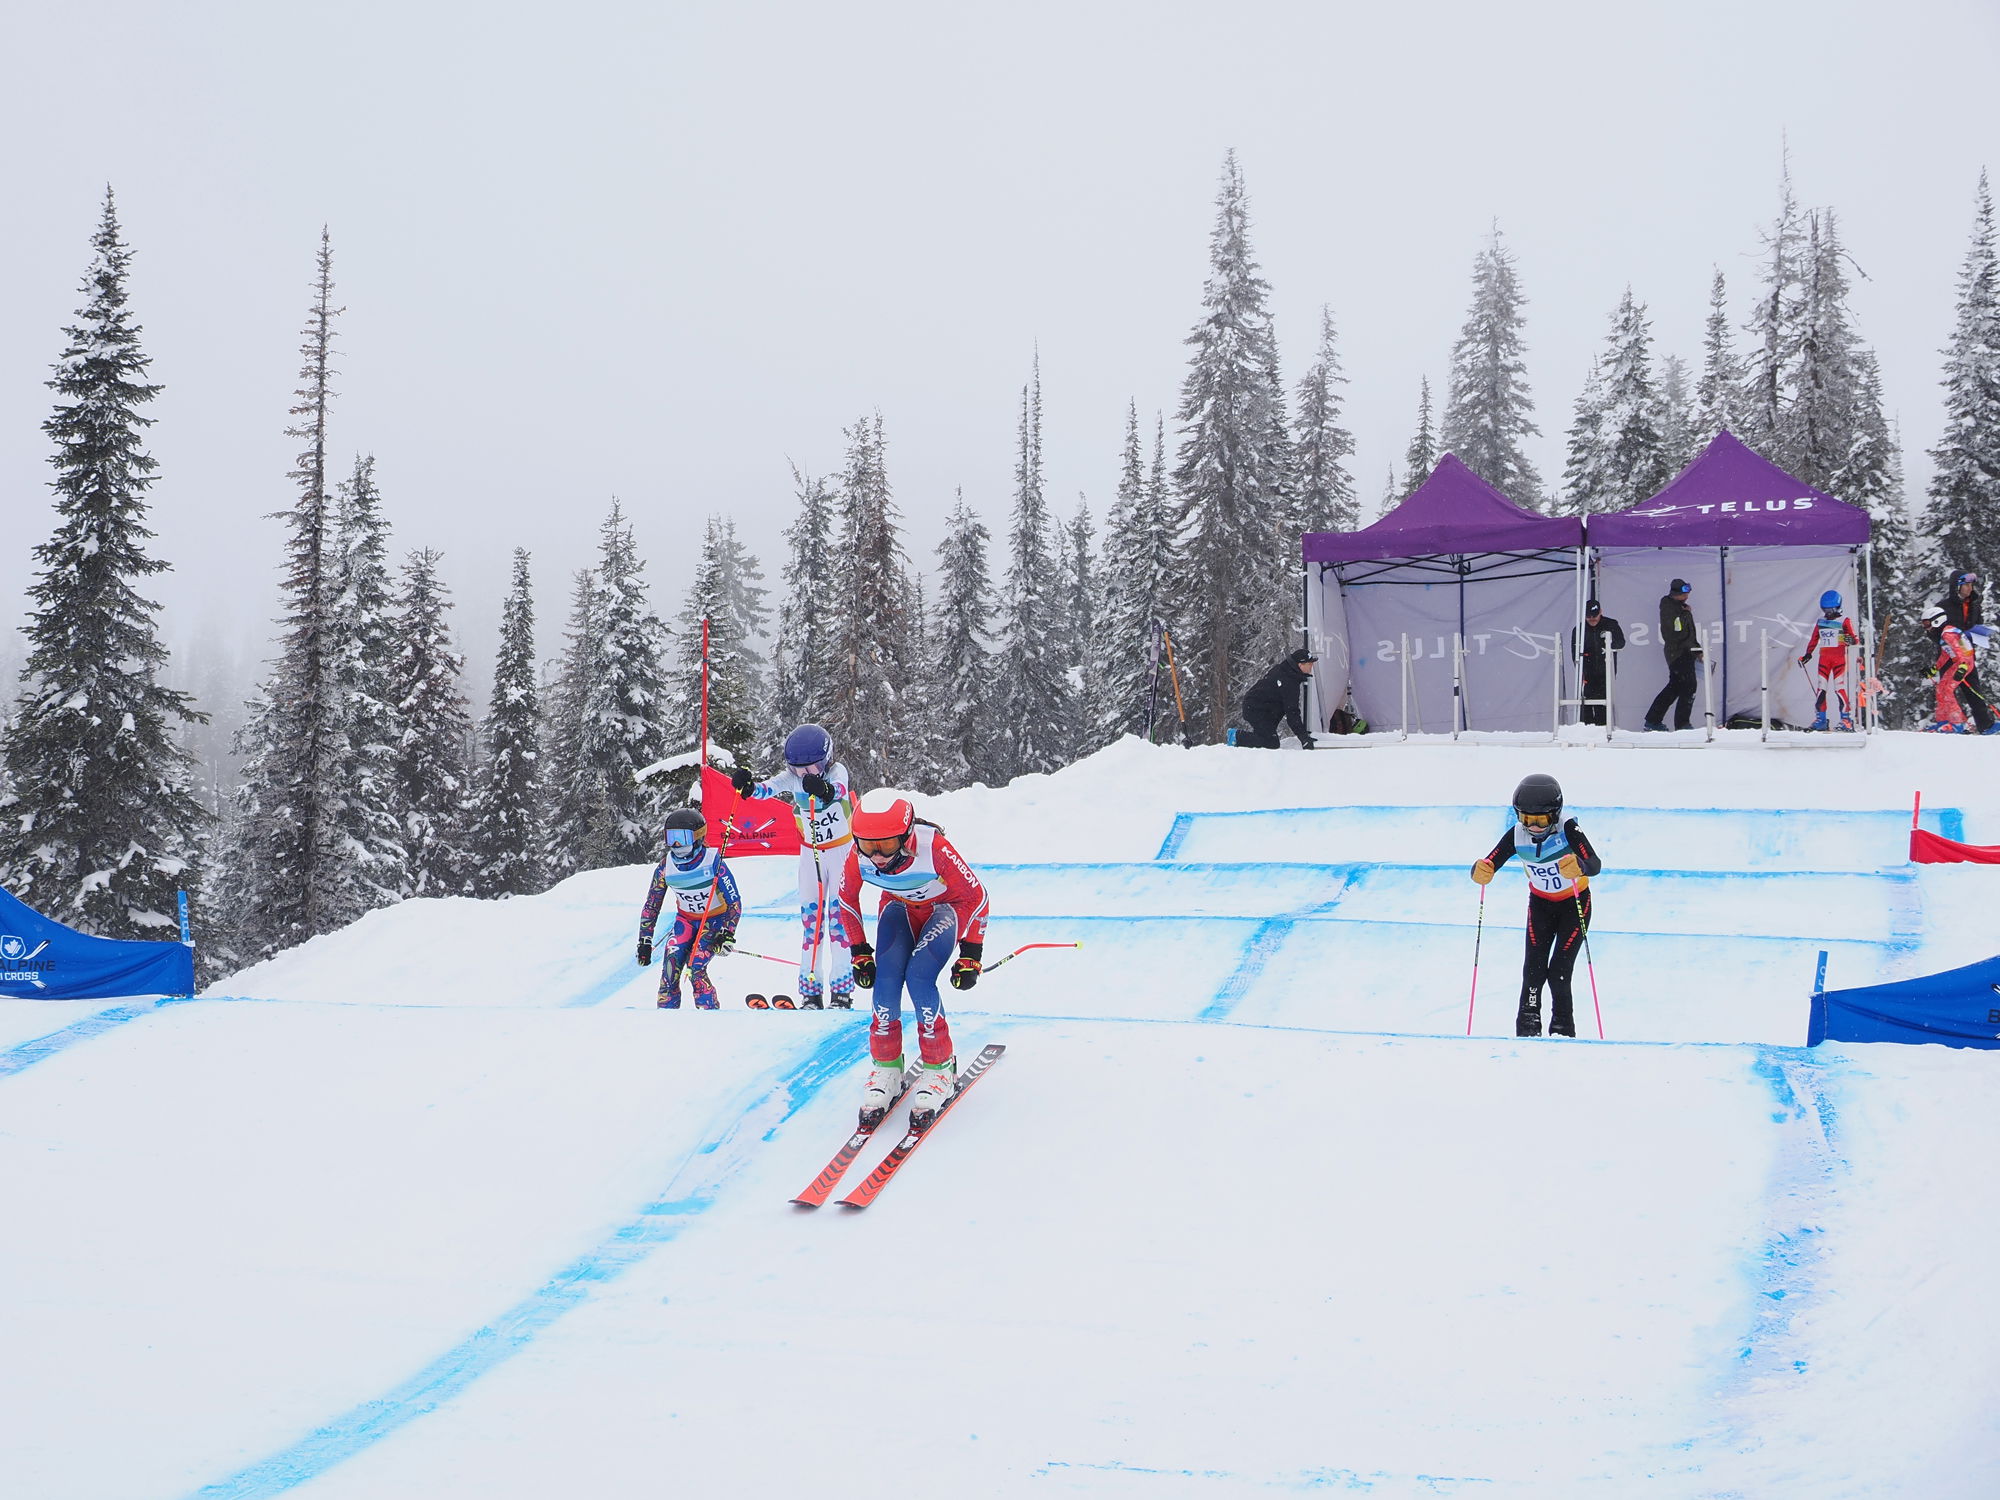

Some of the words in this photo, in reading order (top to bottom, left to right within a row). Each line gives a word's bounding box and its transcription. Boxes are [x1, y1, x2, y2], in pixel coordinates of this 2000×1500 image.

[1697, 497, 1813, 514] TELUS
[739, 831, 777, 840] ALPINE
[941, 846, 979, 888] KARBON
[1541, 877, 1562, 890] 70
[676, 891, 710, 902] Teck
[688, 903, 706, 913] 55
[4, 971, 39, 981] CROSS
